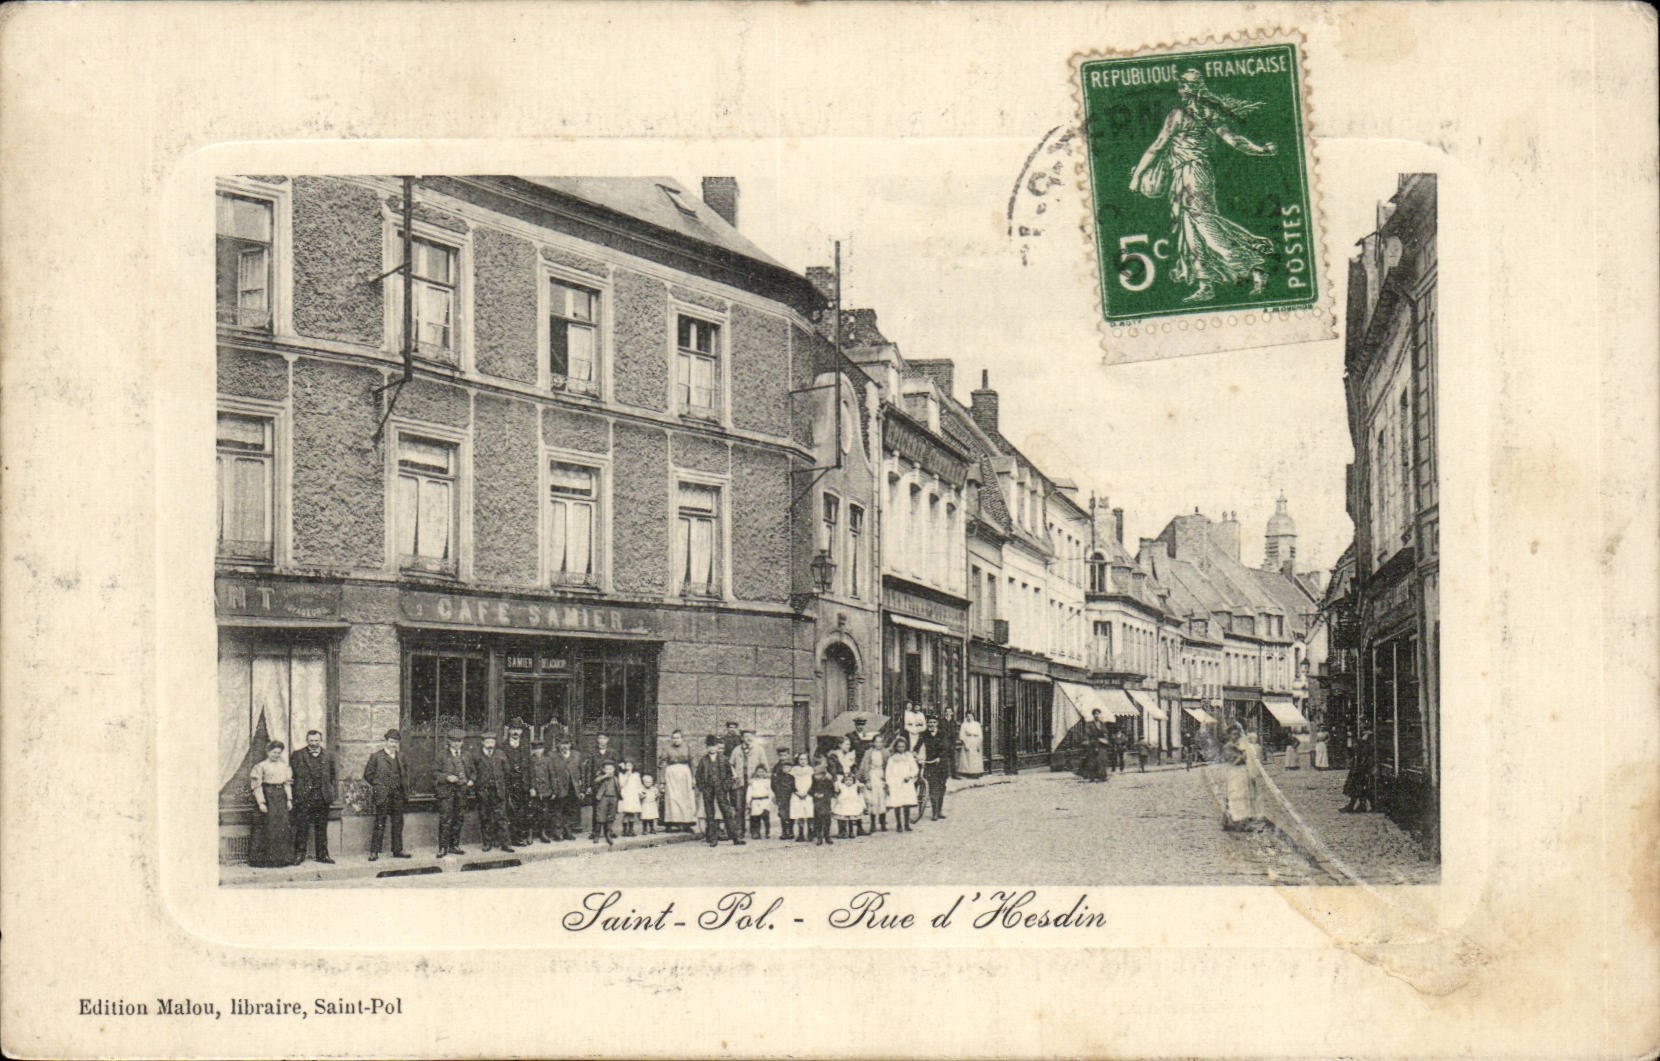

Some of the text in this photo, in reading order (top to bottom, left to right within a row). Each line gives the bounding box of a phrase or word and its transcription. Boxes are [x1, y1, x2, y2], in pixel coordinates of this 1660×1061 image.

[1091, 55, 1288, 88] REPUBLIQUE FRANÇAISE
[1281, 204, 1307, 289] POSTES
[527, 603, 624, 632] SAMIER
